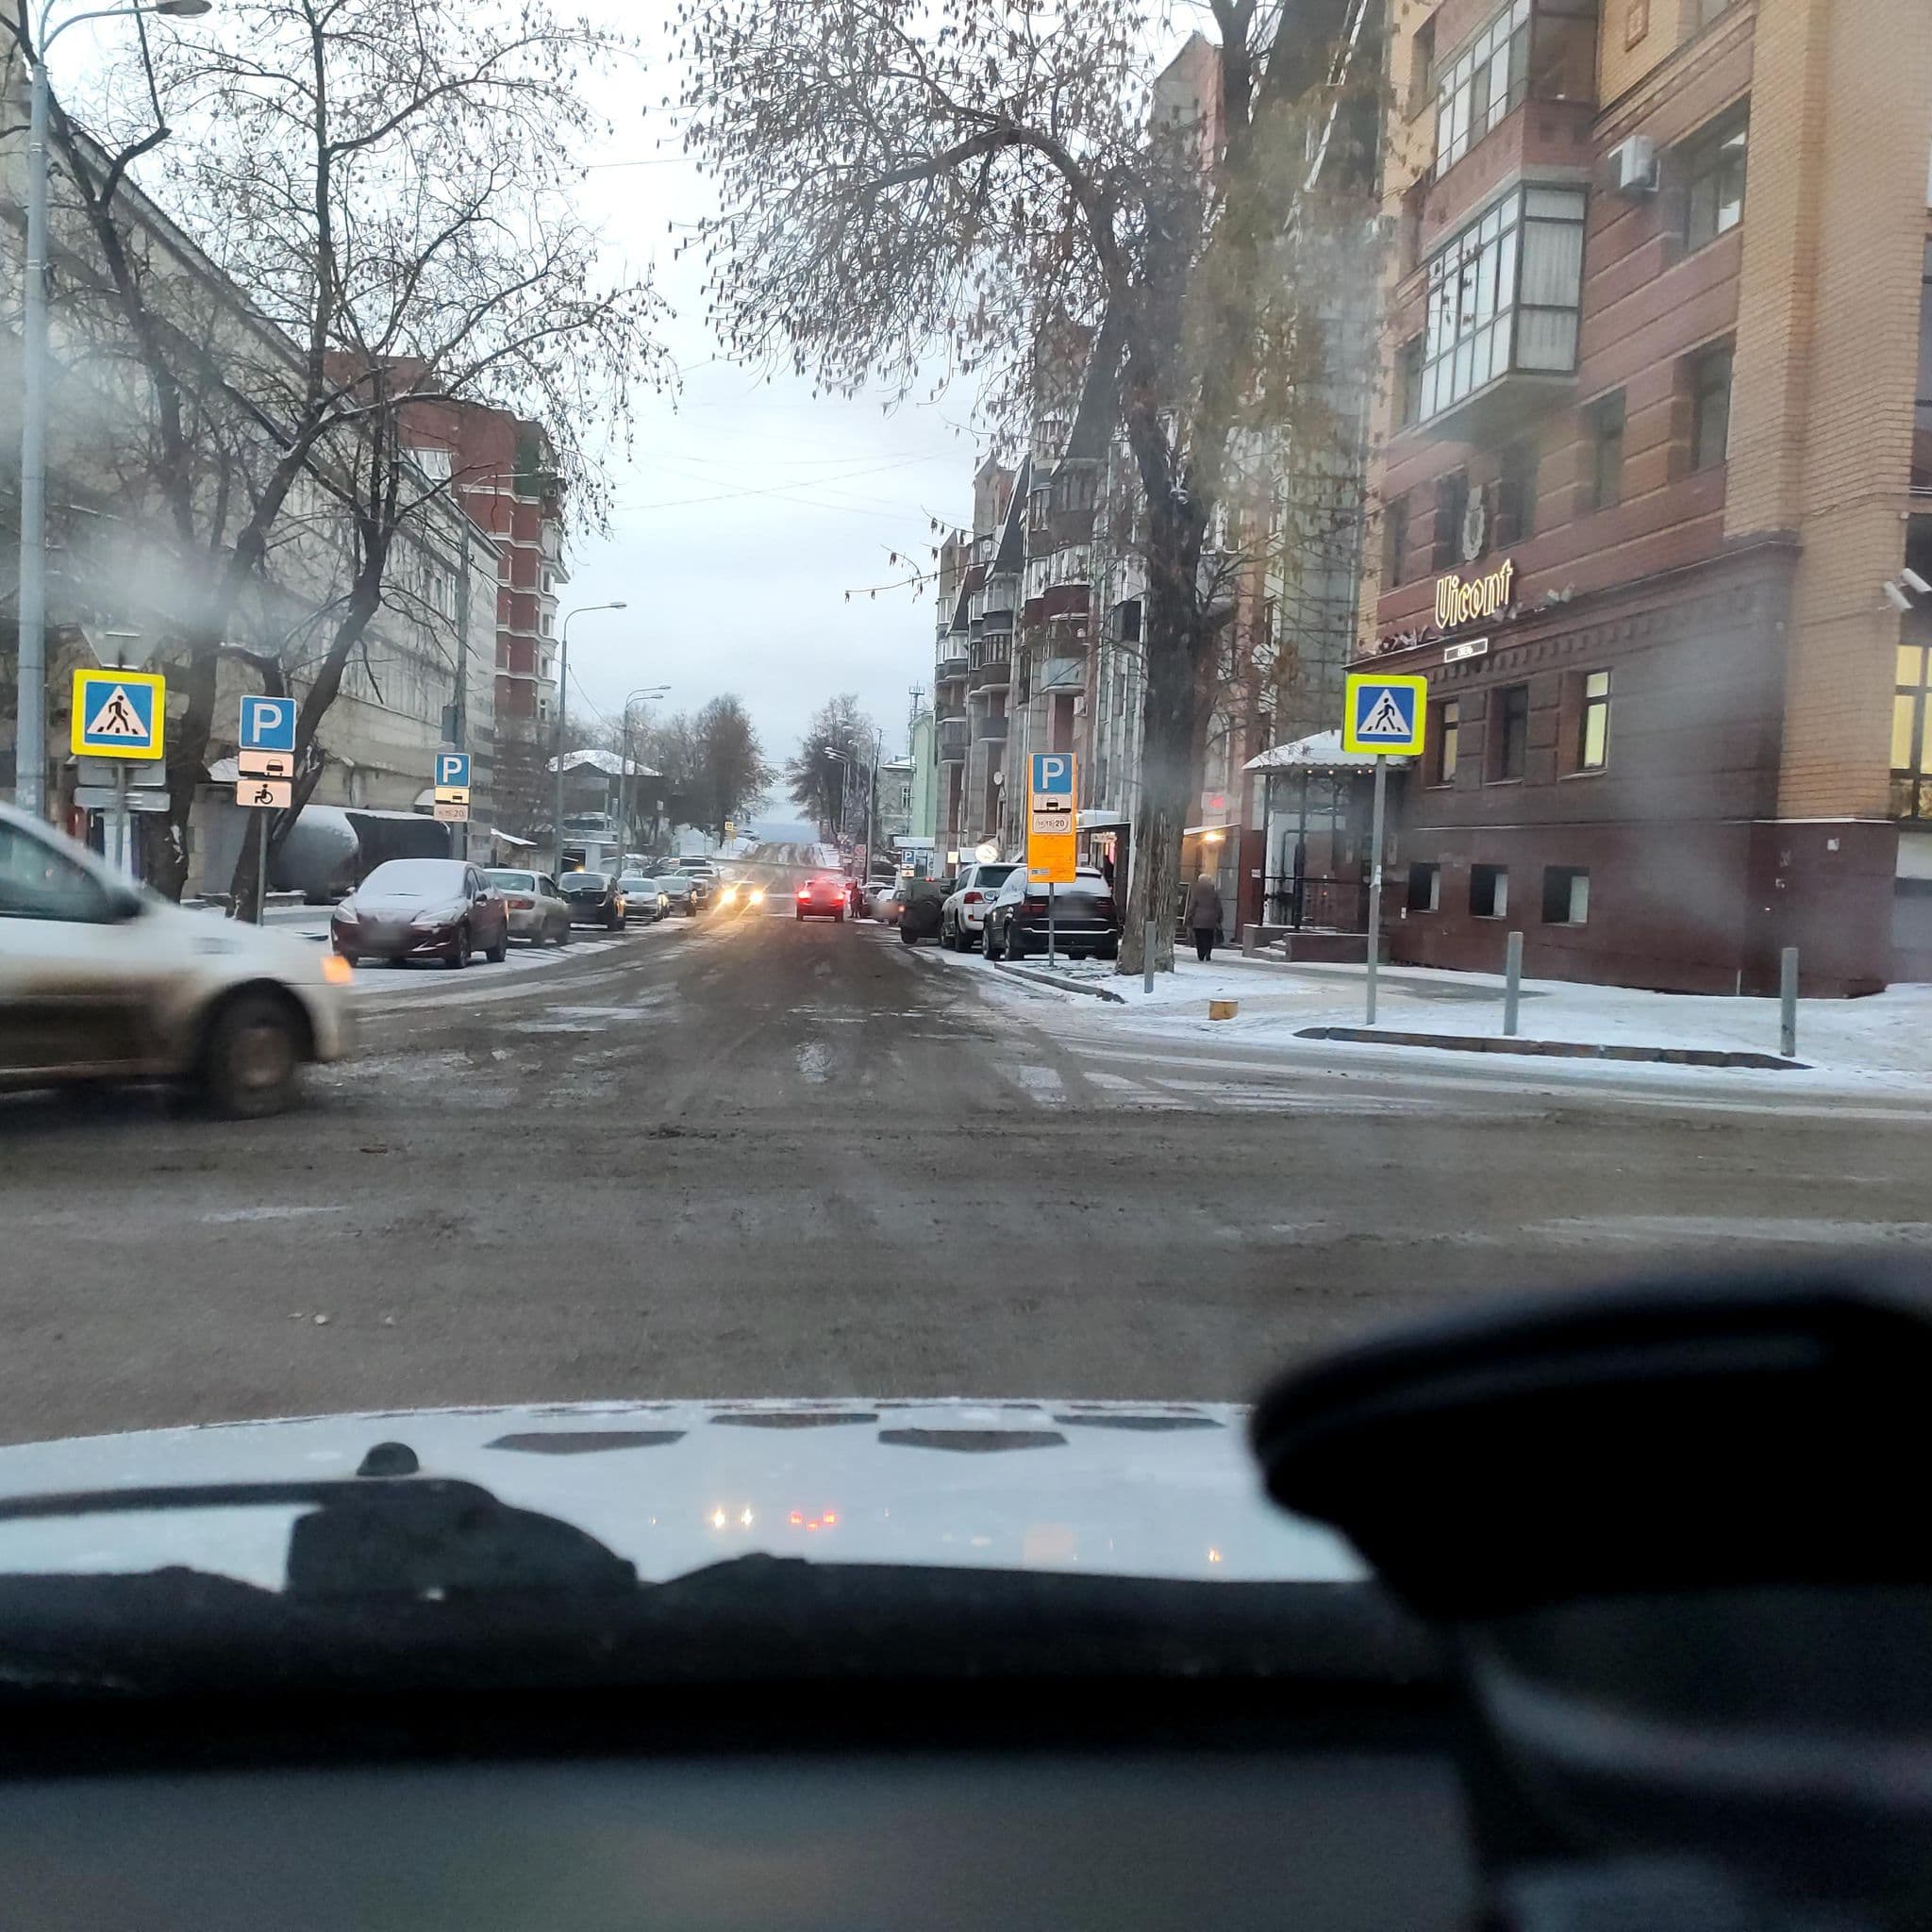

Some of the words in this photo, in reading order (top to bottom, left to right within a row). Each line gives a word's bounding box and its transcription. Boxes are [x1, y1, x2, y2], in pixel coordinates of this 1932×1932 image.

[253, 703, 282, 743] P
[442, 757, 462, 783] P
[1041, 758, 1064, 789] P
